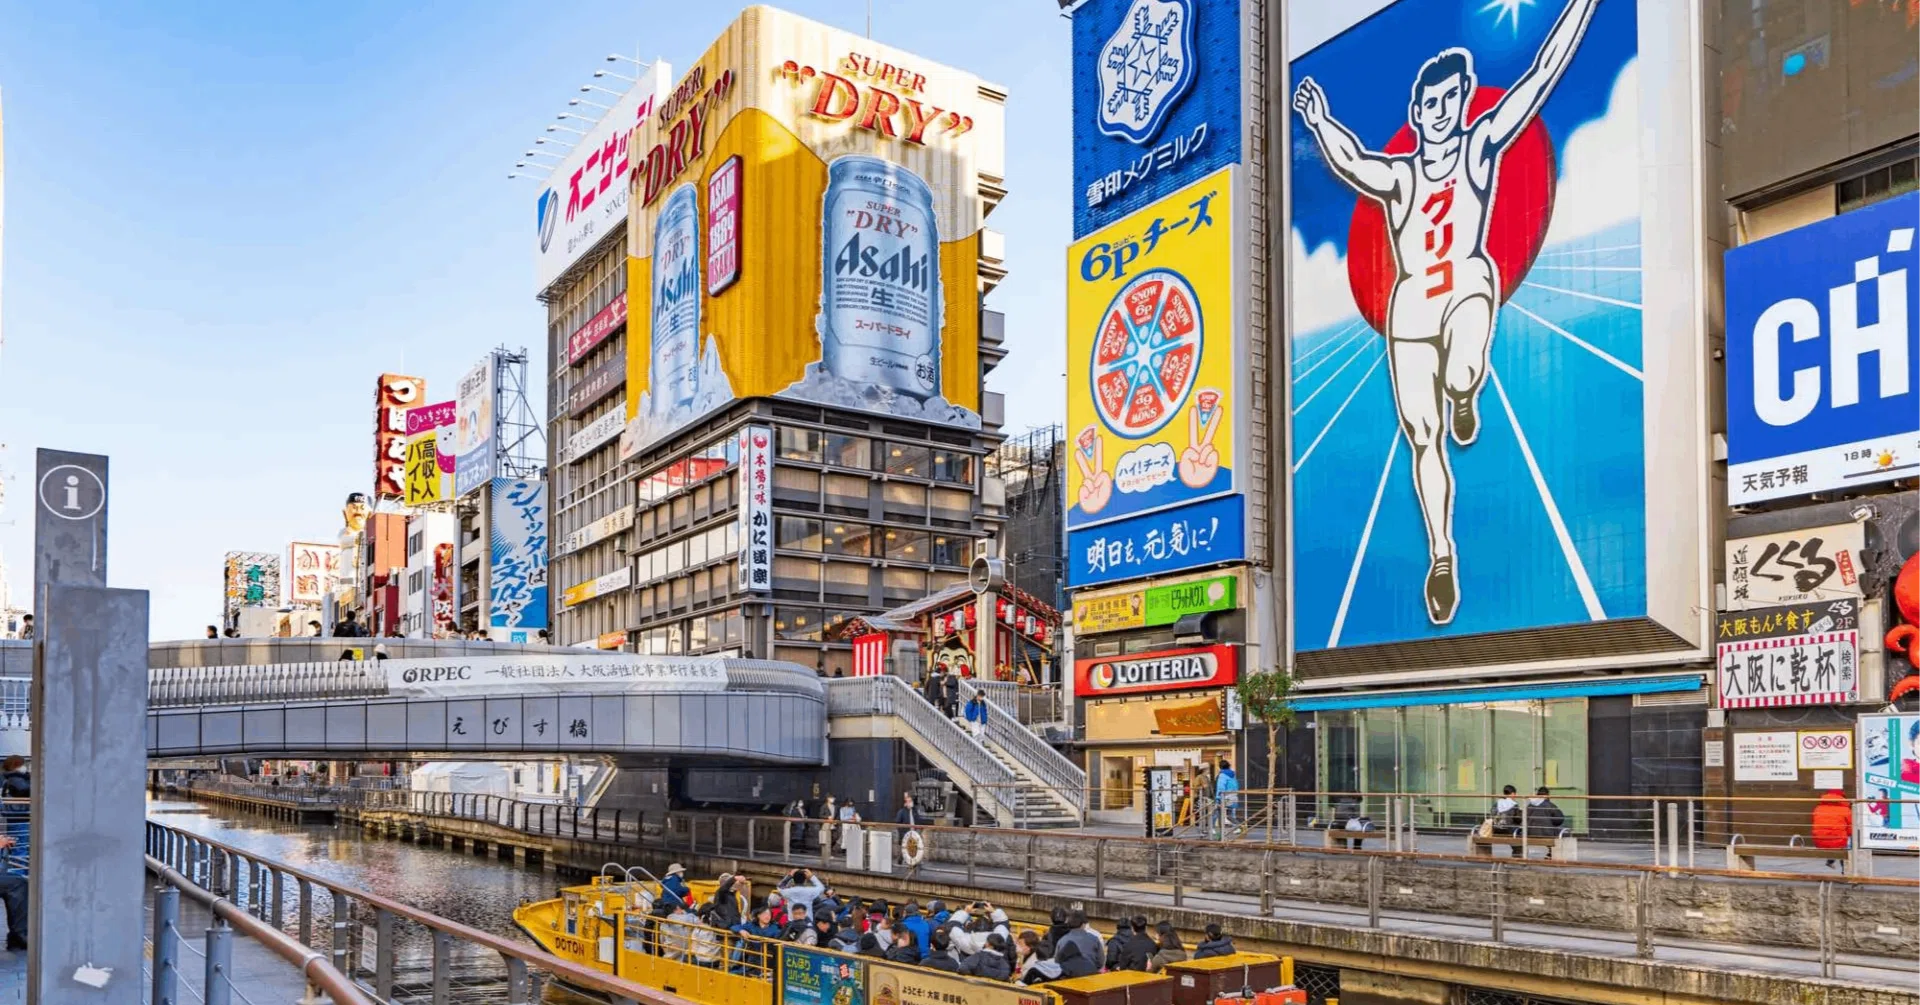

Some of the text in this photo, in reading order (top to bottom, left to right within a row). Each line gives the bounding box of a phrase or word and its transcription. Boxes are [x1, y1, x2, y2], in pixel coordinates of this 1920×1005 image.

[848, 52, 926, 93] SUPER
[659, 65, 702, 131] SUPER
[1086, 122, 1208, 208] 雪印メグミルク
[710, 166, 735, 214] ASAHI
[866, 200, 901, 217] SUPER
[710, 210, 734, 252] 1889
[1421, 178, 1457, 299] グリコ
[835, 232, 928, 293] Asahi
[655, 254, 695, 322] Asahi
[871, 287, 895, 309] 生
[1131, 285, 1158, 304] SNOW
[669, 312, 680, 334] 生
[1170, 295, 1192, 326] SNOW
[855, 319, 911, 340] スーパードライ
[408, 440, 424, 501] バイト
[421, 439, 436, 499] 高収入
[1742, 465, 1808, 493] 天気予報
[752, 510, 768, 585] かに道楽
[1732, 545, 1749, 600] 道頓堀
[1750, 537, 1836, 592] くくる
[1171, 586, 1204, 610] ピタットハウス
[1720, 609, 1815, 638] 大阪もんを食す
[1836, 616, 1854, 630] 2F
[485, 665, 575, 679] 一般社団法人
[1117, 657, 1205, 683] LOTTERIA
[1725, 646, 1837, 696] 大阪に乾杯
[453, 717, 587, 738] えびす橋
[555, 936, 585, 957] DOTON
[927, 991, 940, 1000] 大阪
